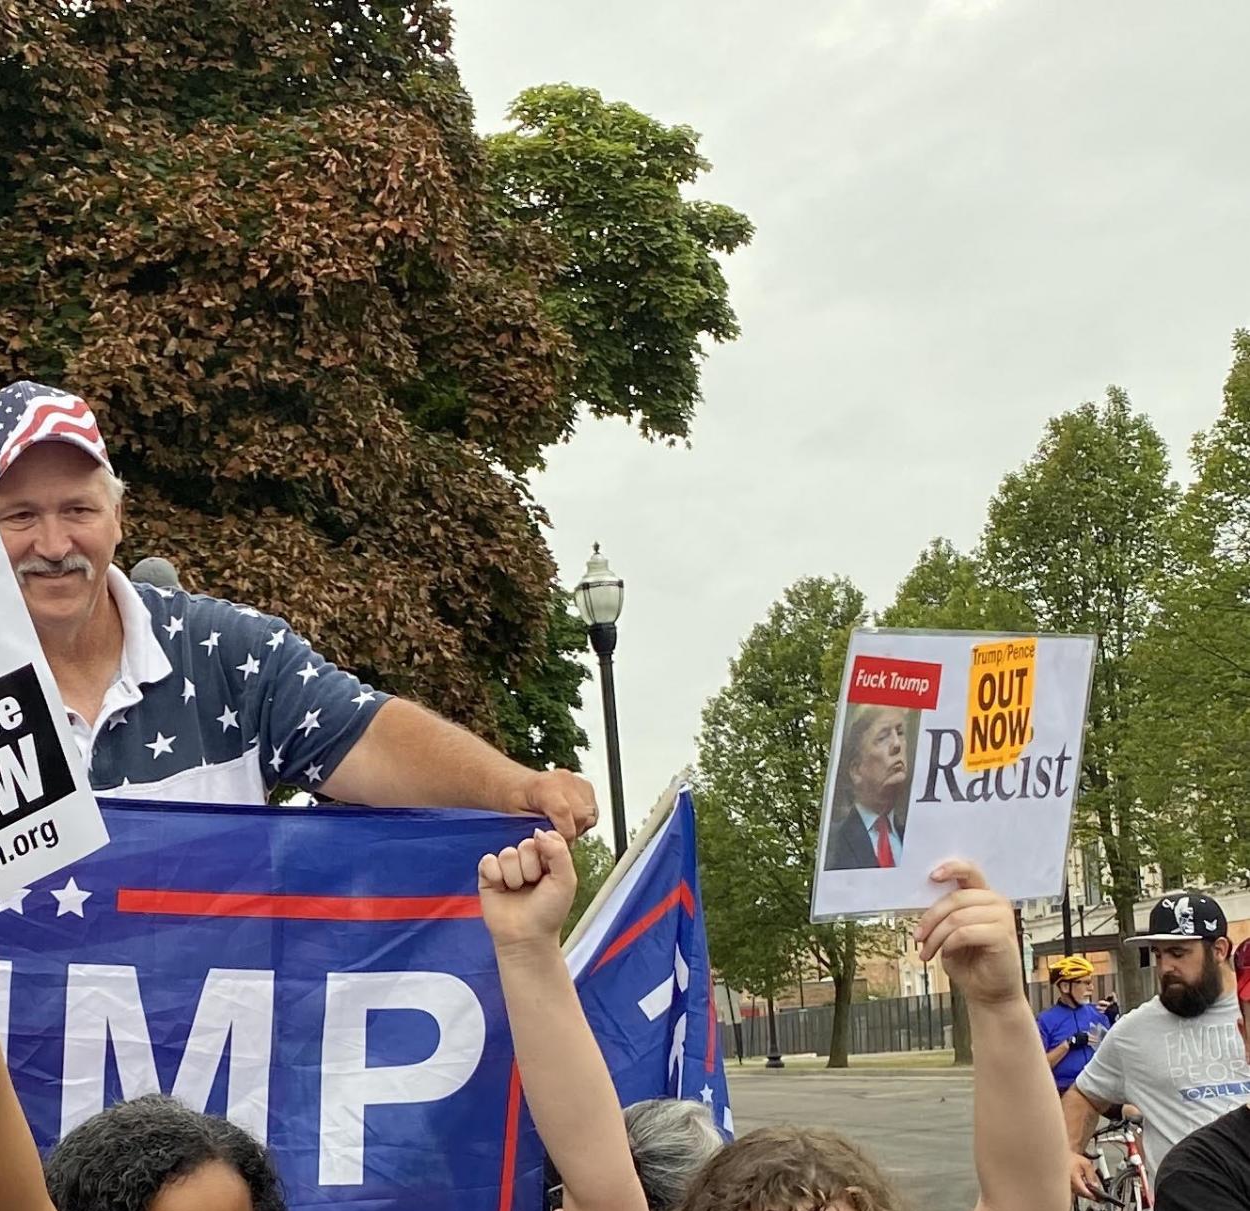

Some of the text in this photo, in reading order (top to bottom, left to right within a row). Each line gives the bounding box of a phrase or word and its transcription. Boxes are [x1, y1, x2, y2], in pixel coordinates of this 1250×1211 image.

[972, 645, 1036, 667] Trump/Pence
[856, 670, 930, 695] Fuck Trump
[978, 667, 1028, 711] OUT
[970, 707, 1030, 754] NOW
